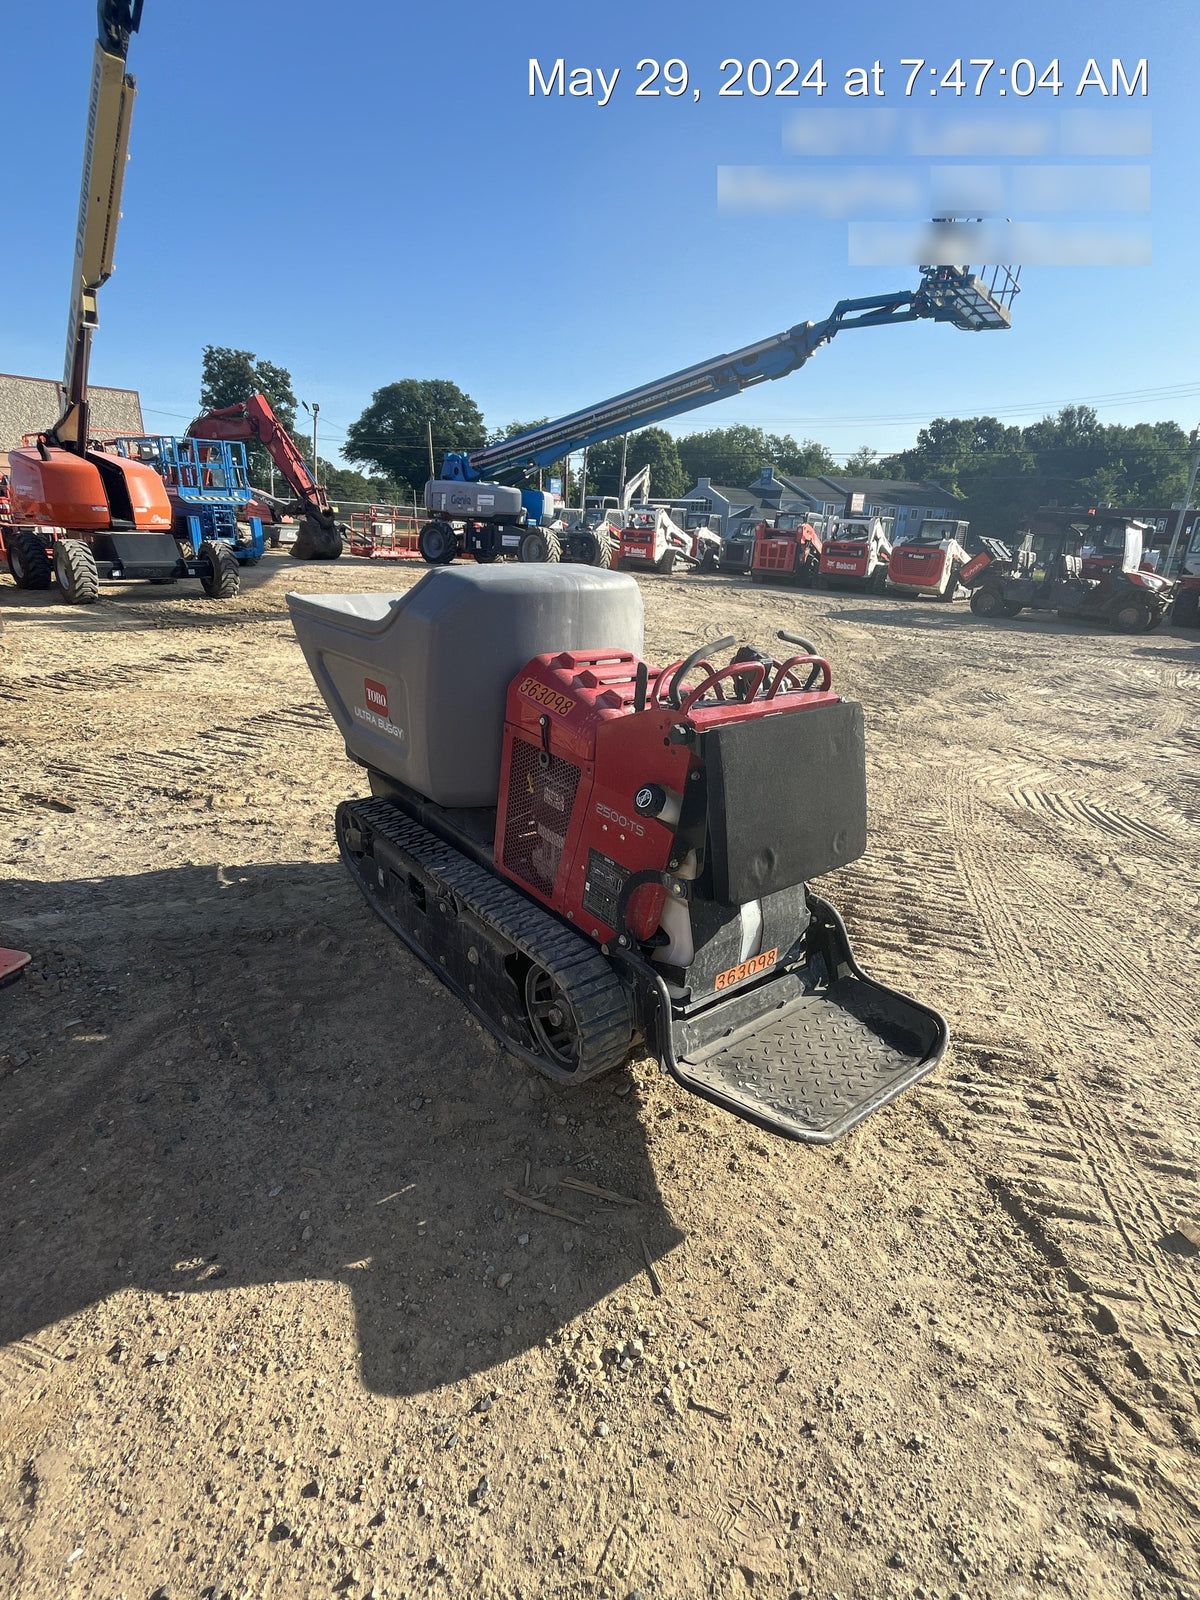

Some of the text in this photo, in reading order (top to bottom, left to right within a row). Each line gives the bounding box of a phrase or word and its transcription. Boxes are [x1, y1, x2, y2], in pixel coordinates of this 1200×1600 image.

[78, 63, 102, 239] EquipmentShare
[450, 493, 472, 506] Genie
[835, 561, 857, 571] Bobcat
[365, 687, 388, 707] TORO
[520, 679, 573, 715] 363098
[354, 705, 404, 740] ULTRA BUGGY
[717, 950, 776, 990] 363098
